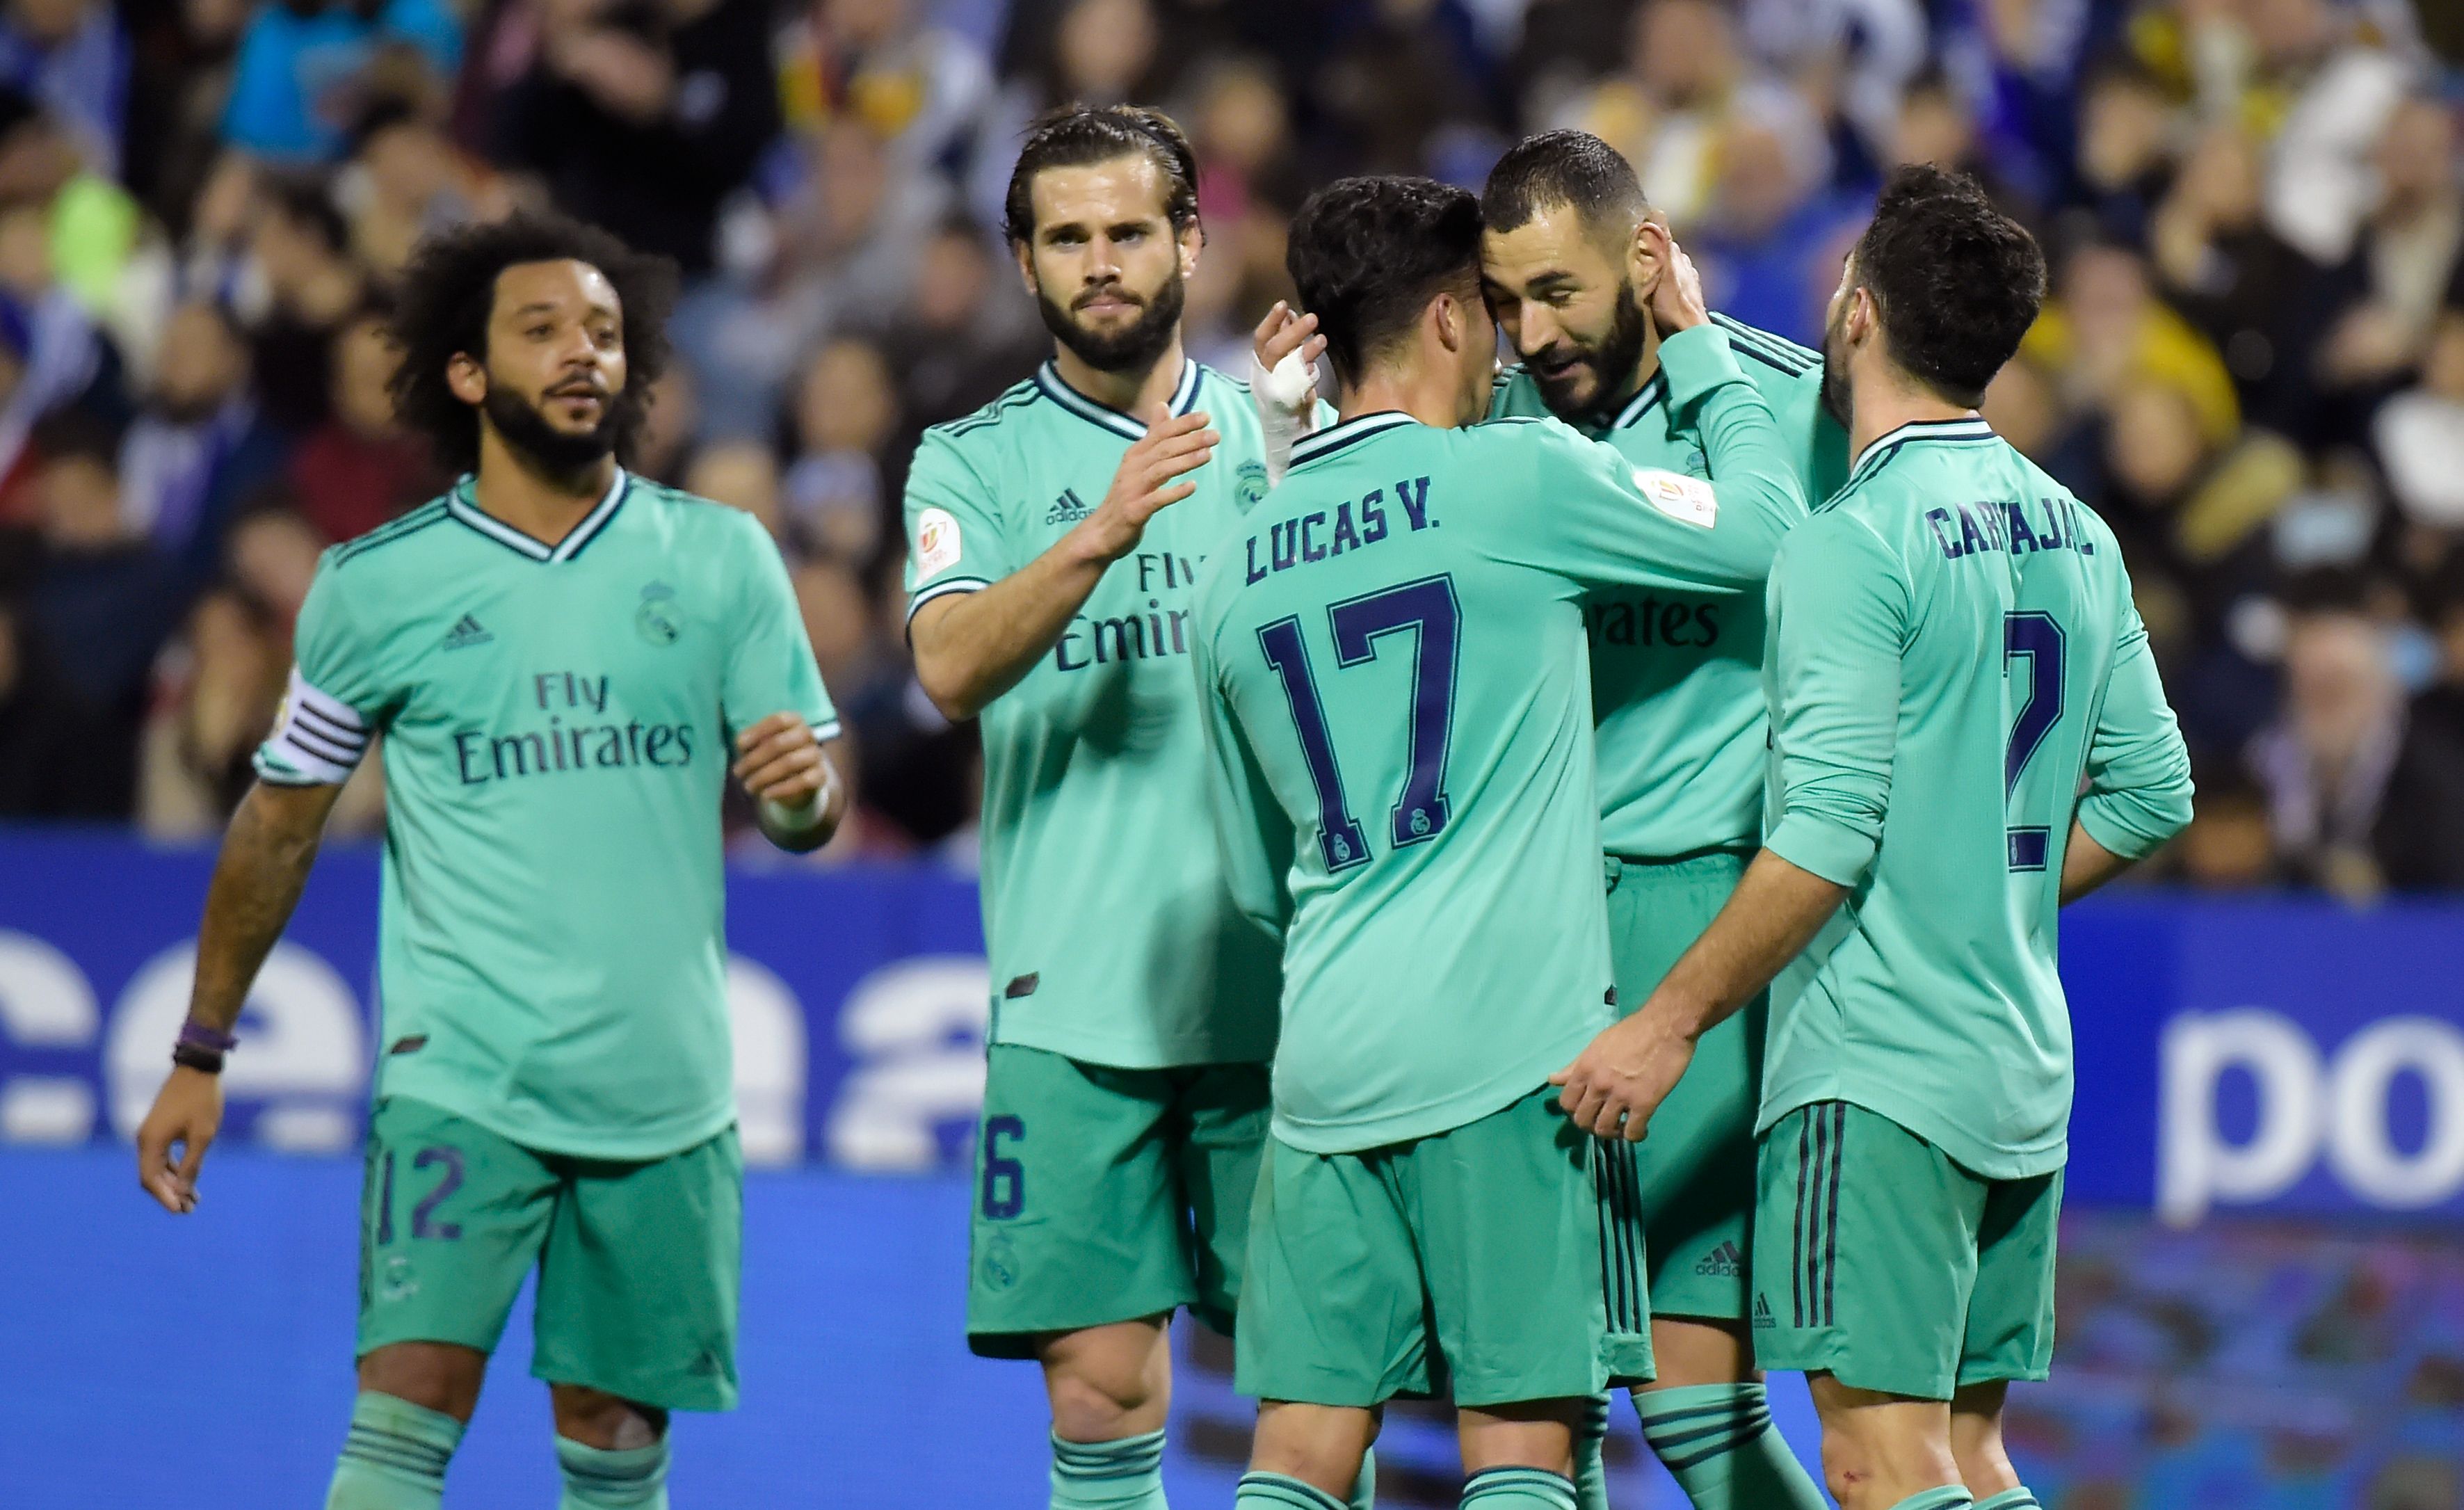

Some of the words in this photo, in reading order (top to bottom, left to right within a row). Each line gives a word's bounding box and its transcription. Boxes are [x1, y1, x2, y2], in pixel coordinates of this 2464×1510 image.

[1246, 488, 1390, 586] LUCAS
[1396, 476, 1440, 532] V.
[534, 670, 609, 713] Fly
[1256, 572, 1463, 874] 17
[454, 715, 693, 785] Emirates
[378, 1146, 464, 1245] 12
[983, 1116, 1025, 1221] 6
